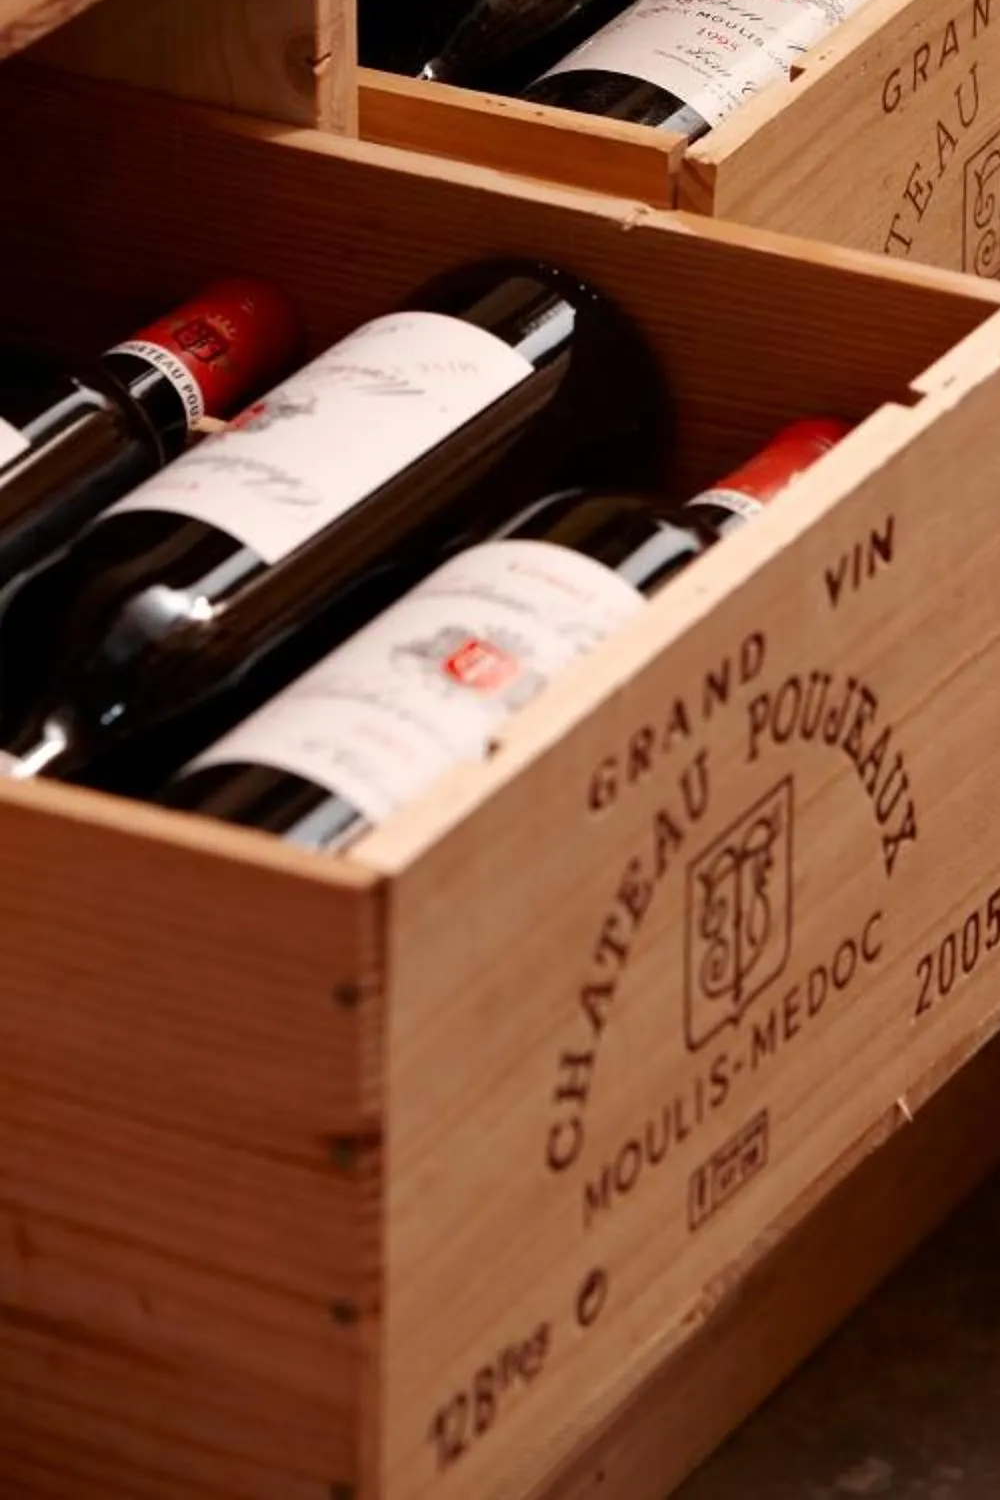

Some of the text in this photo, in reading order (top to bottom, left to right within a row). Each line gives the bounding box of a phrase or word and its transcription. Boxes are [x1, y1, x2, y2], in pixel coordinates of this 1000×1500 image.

[587, 516, 896, 814] GRAND VIN
[547, 670, 918, 1176] CHATEAU POUJEAUX
[582, 909, 885, 1230] MOULIS-MEDOC
